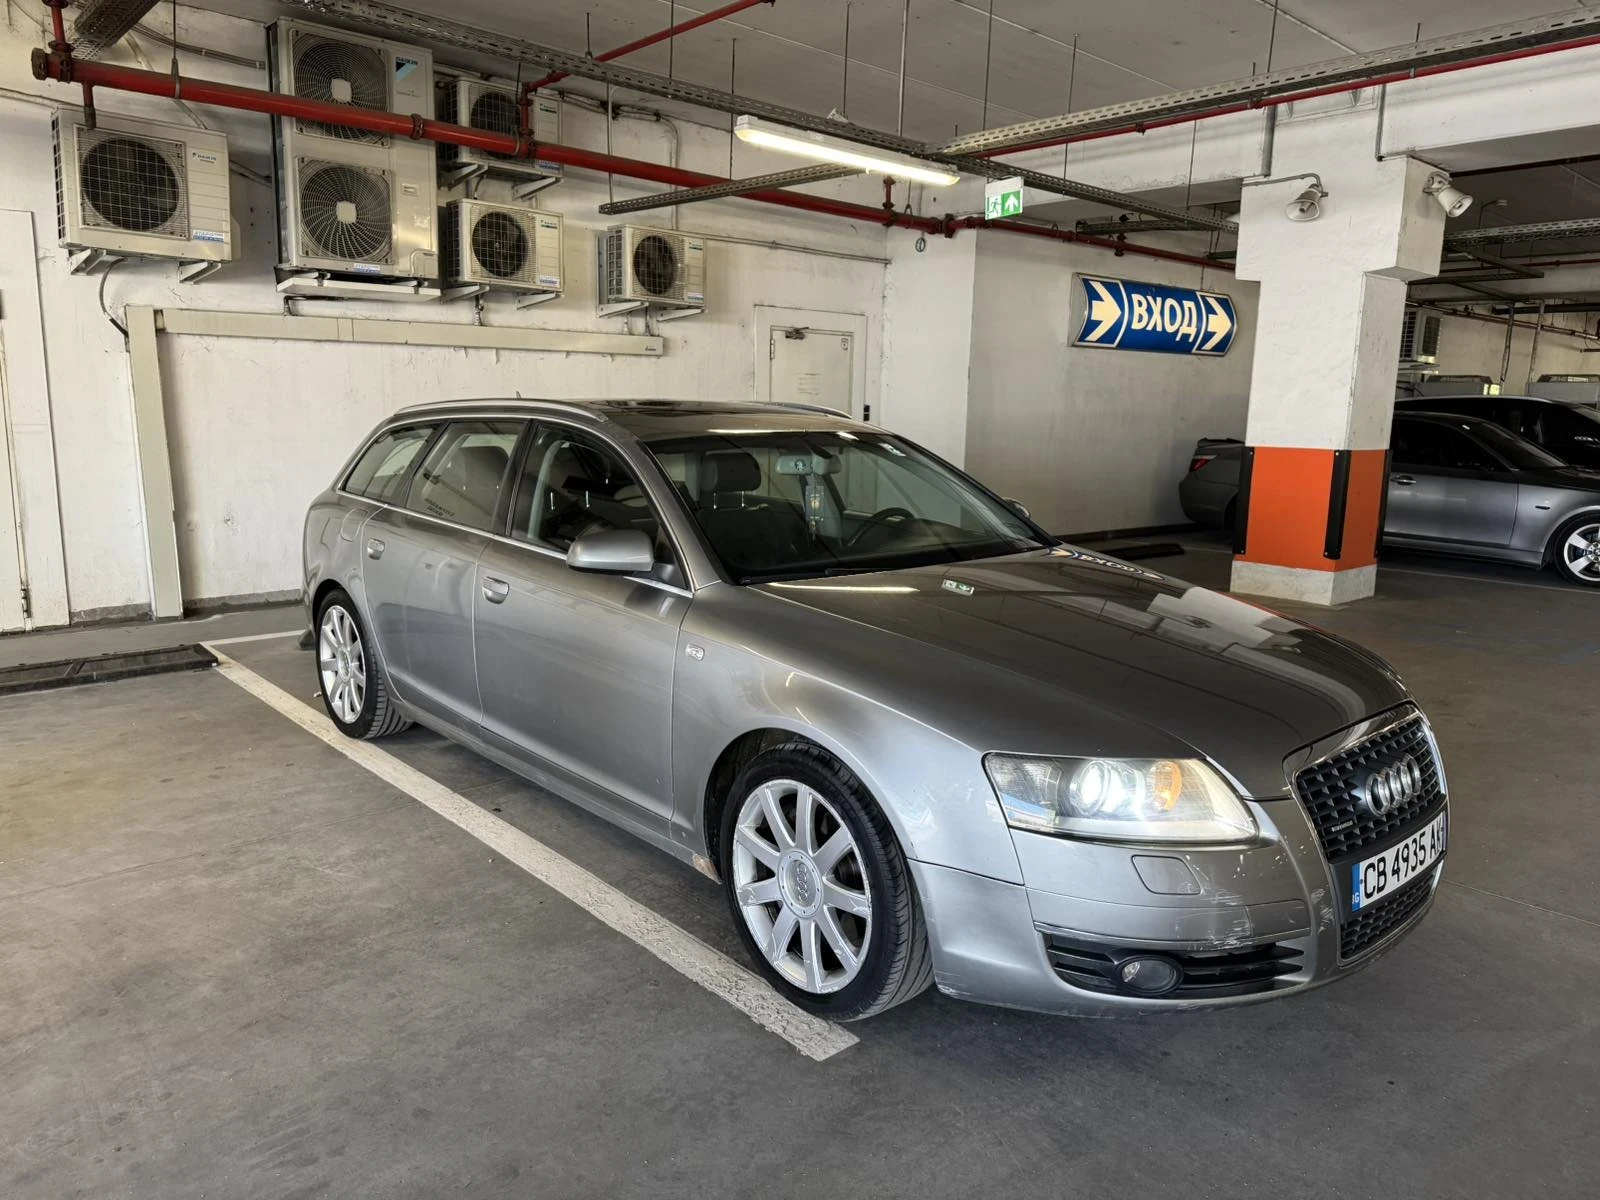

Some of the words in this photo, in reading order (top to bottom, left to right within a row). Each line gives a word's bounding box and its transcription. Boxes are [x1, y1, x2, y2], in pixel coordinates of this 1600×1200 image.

[1131, 294, 1197, 342] ВХОД
[1364, 856, 1387, 899] CB
[1391, 831, 1427, 883] 4935
